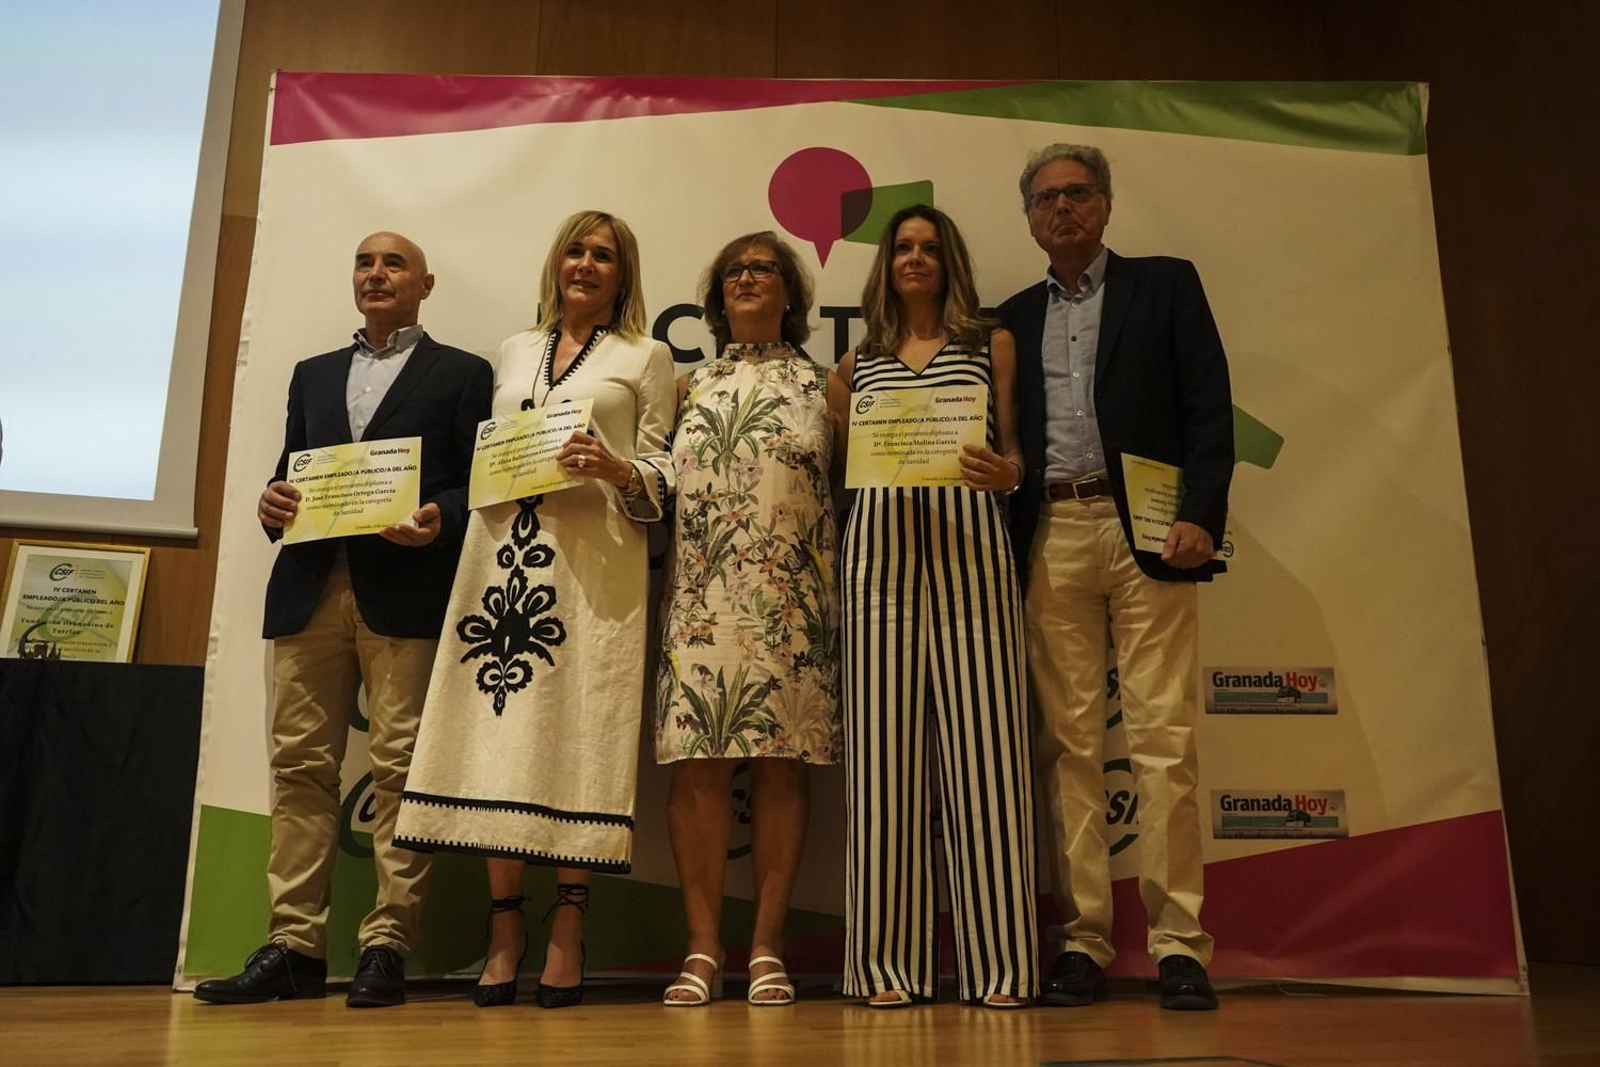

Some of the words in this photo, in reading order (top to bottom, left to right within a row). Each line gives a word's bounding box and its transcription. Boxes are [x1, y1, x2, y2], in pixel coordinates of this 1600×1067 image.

[482, 441, 505, 450] CERTAMEN
[506, 433, 535, 444] EMPLEADO/A
[536, 427, 563, 436] PÚBLICO/A
[538, 440, 558, 449] diploma
[296, 474, 324, 483] CERTAMEN
[324, 470, 360, 479] EMPLEADO/A
[360, 466, 391, 474] PÚBLICO/A
[518, 468, 537, 477] Sanidad
[340, 482, 362, 491] presente
[362, 480, 388, 488] diploma
[324, 492, 352, 500] Francisco
[354, 490, 374, 498] Ortega
[366, 497, 392, 505] categoría
[62, 620, 103, 628] Granadina
[1212, 672, 1283, 688] Granada
[1286, 672, 1318, 691] Hoy
[1220, 794, 1292, 812] Granada
[1294, 795, 1328, 815] Hoy
